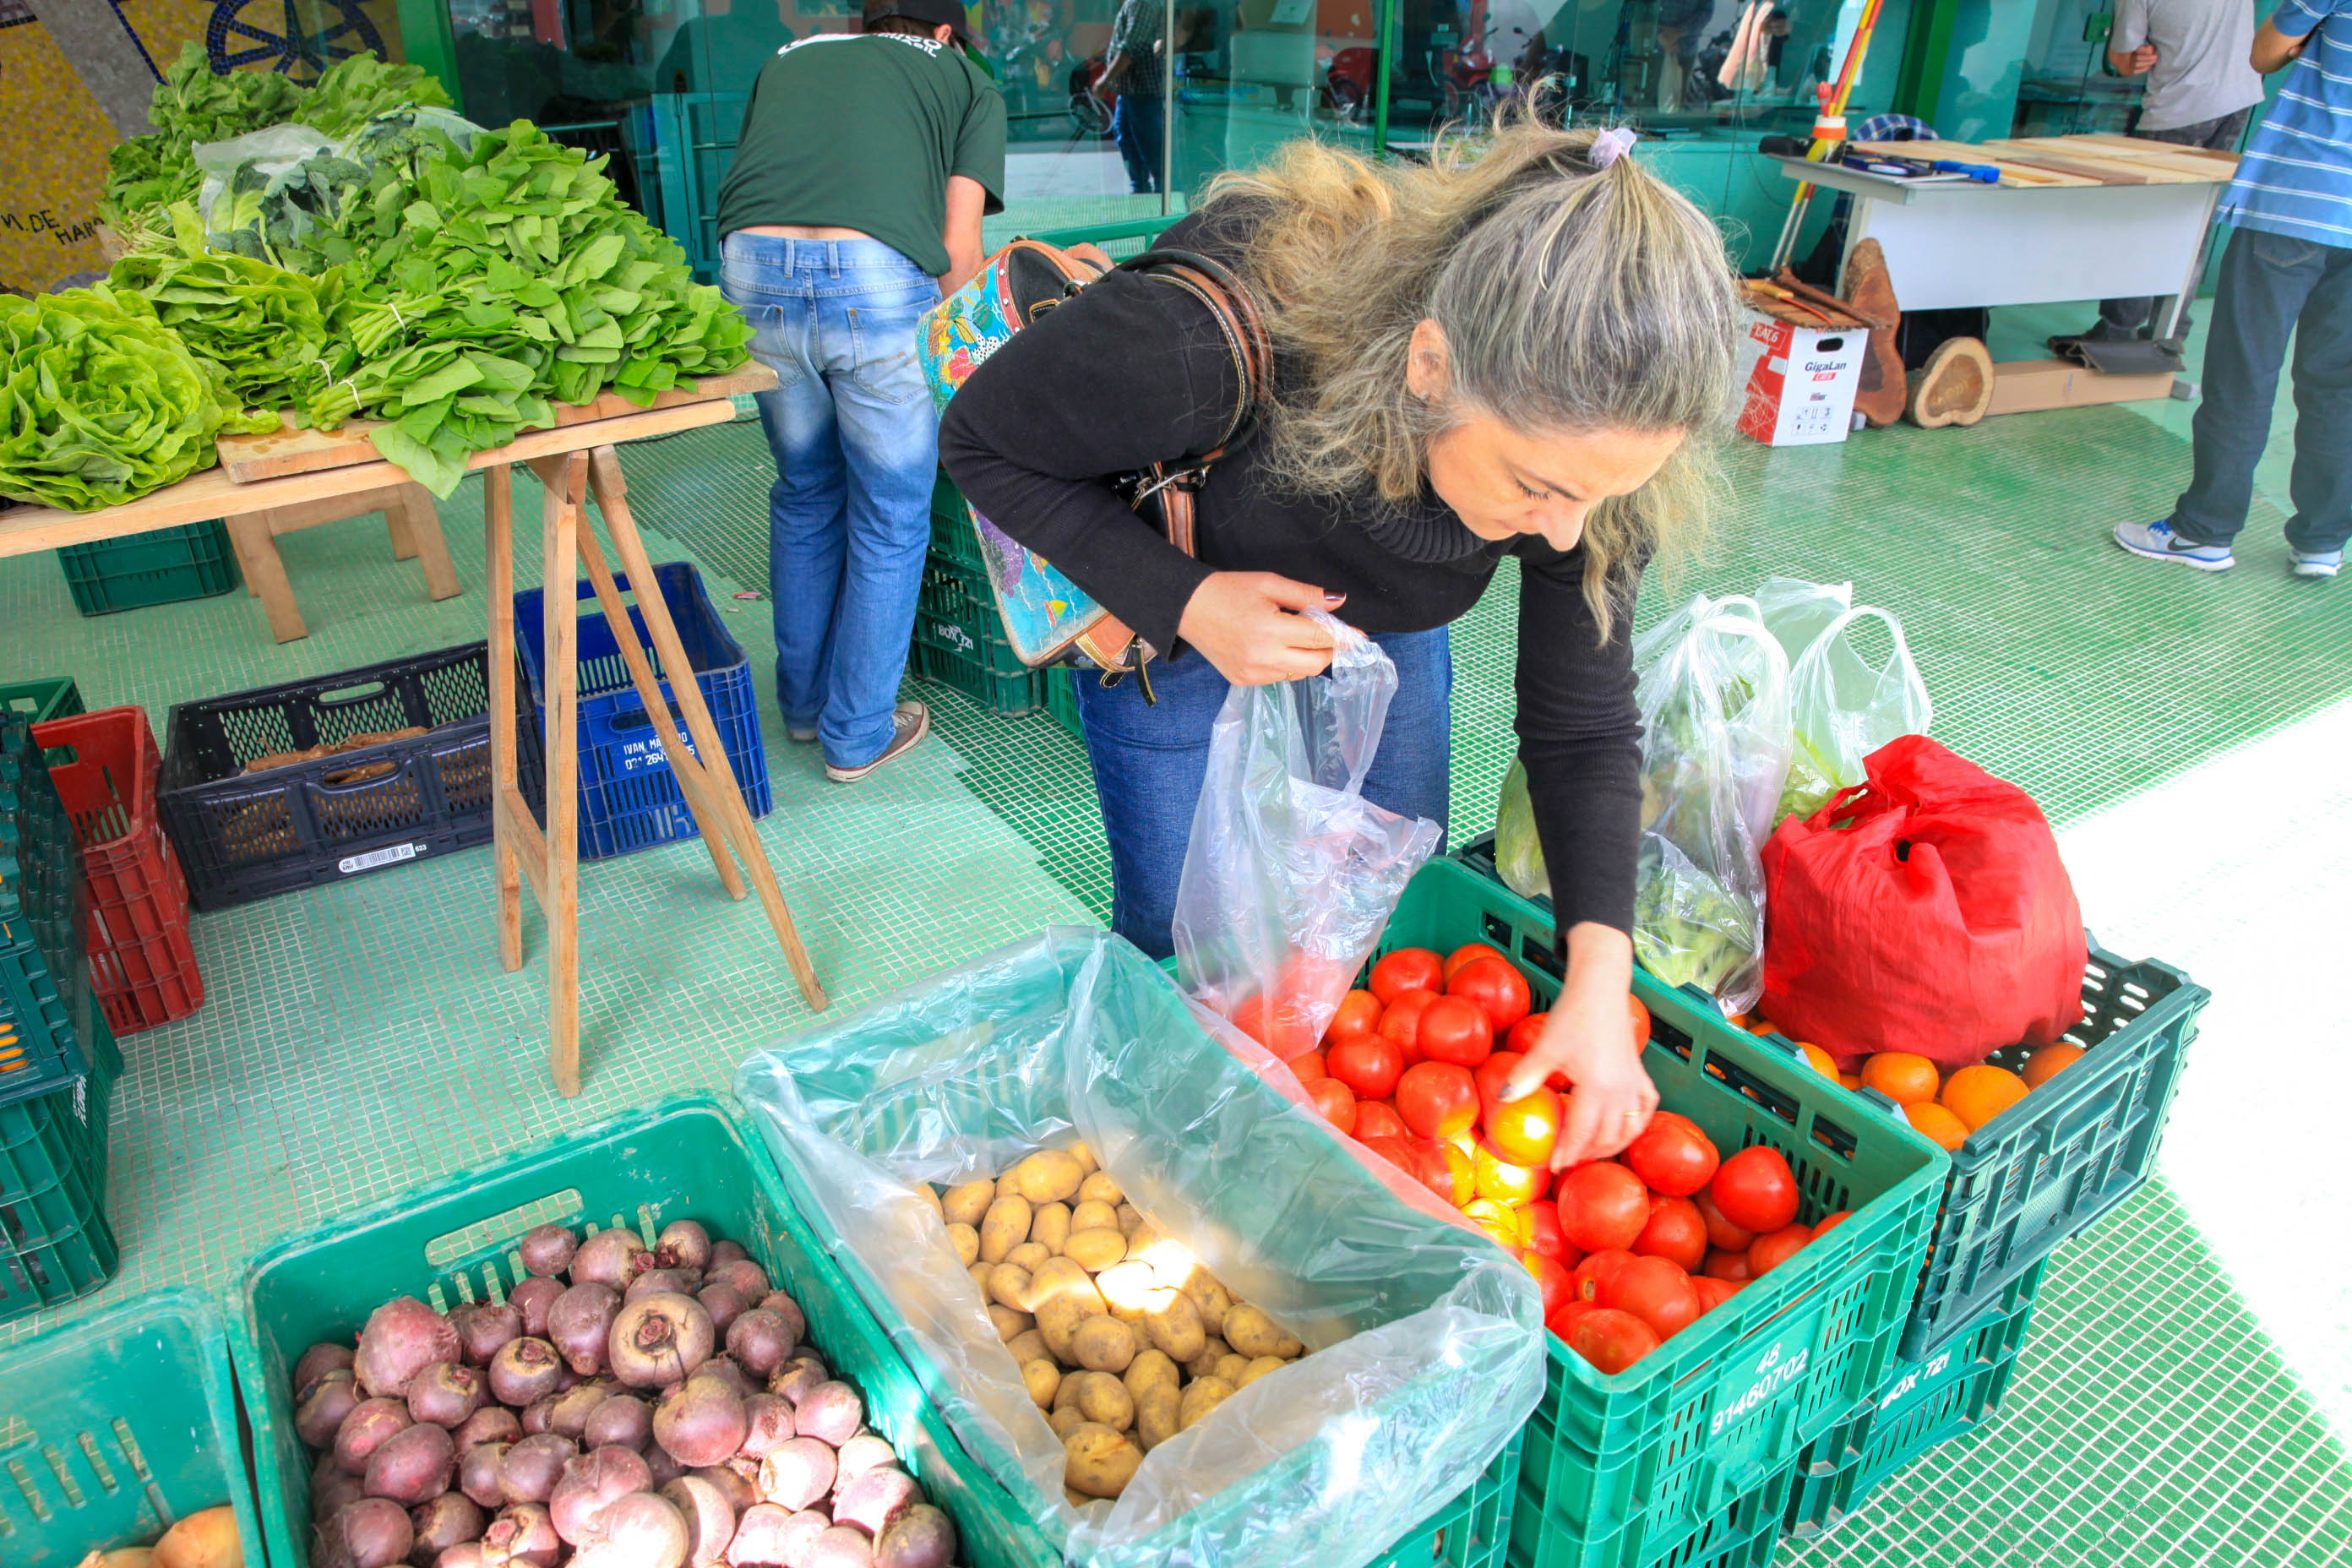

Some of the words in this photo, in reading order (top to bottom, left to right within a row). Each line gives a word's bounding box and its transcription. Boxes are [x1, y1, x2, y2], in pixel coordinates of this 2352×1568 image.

[1805, 361, 1846, 372] GigaLan
[938, 624, 958, 642] BOX
[623, 741, 645, 755] IVAN
[415, 844, 427, 852] 623
[1924, 1349, 1952, 1380] 721
[1710, 1348, 1809, 1435] 91460702
